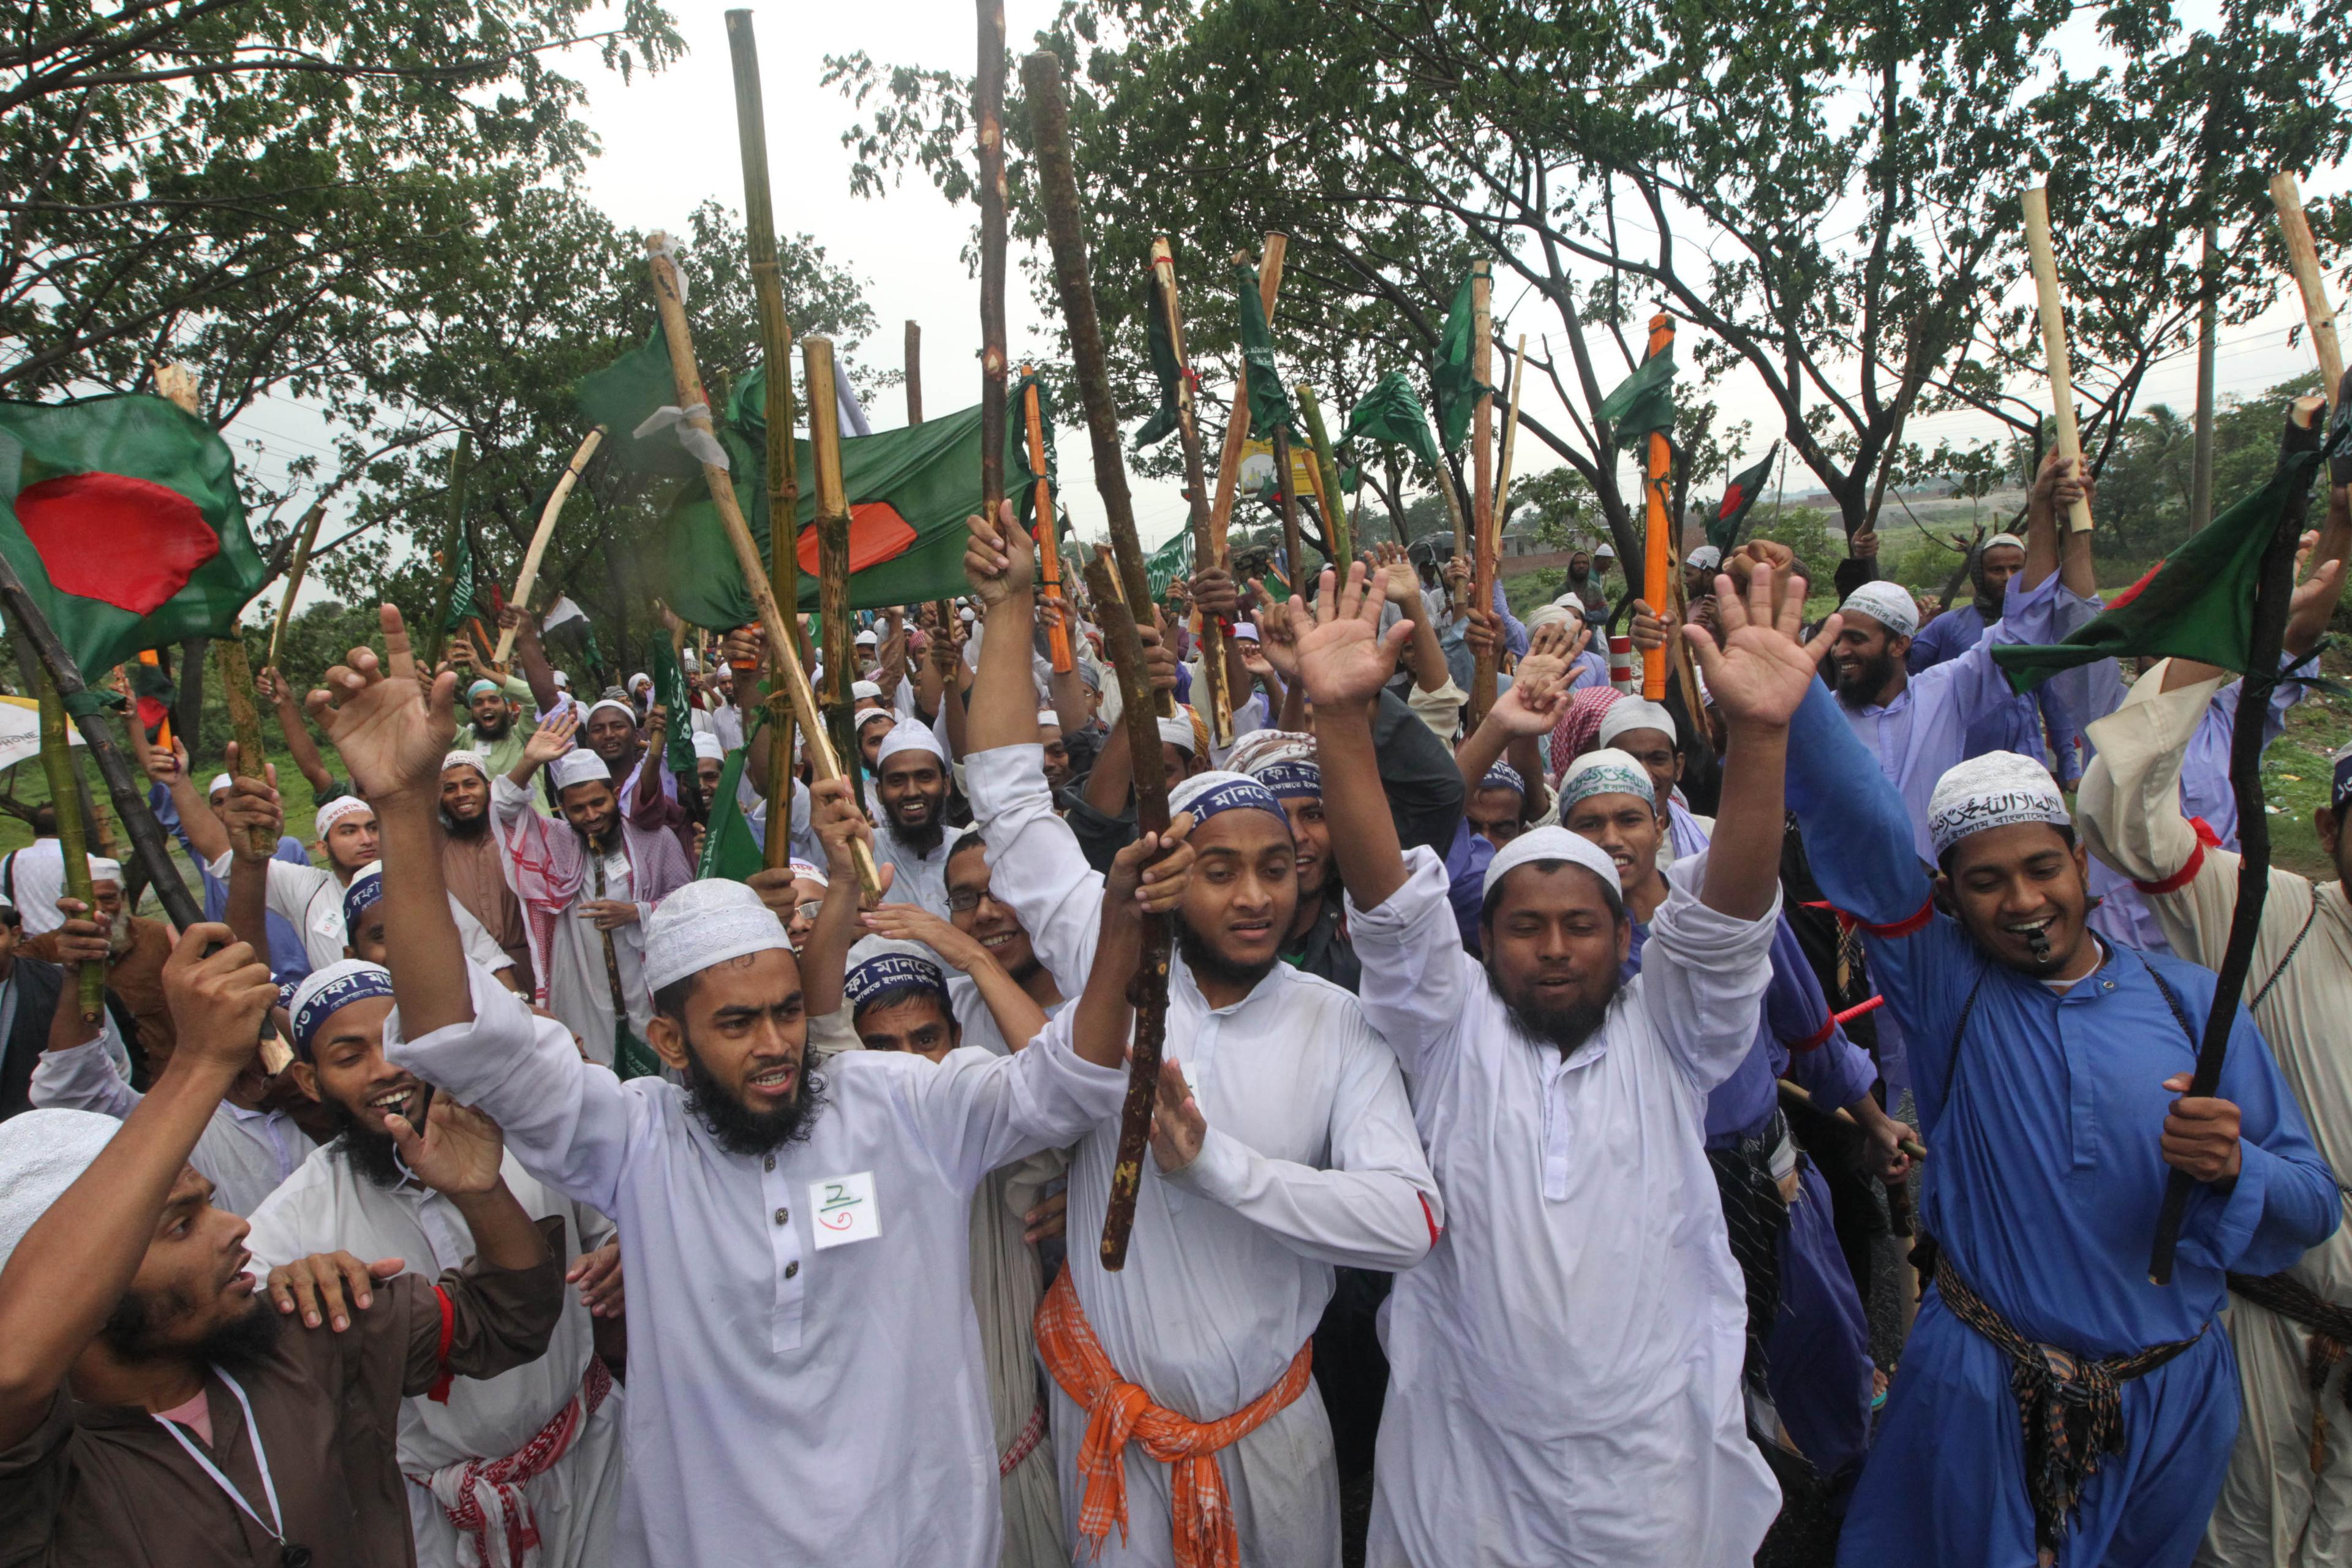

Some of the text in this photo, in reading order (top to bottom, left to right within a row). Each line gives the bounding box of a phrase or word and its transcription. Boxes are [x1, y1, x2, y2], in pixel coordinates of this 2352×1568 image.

[0, 732, 39, 746] HONE
[1995, 812, 2052, 825] বাংলাদেশ
[843, 957, 937, 998] ফা মানতে
